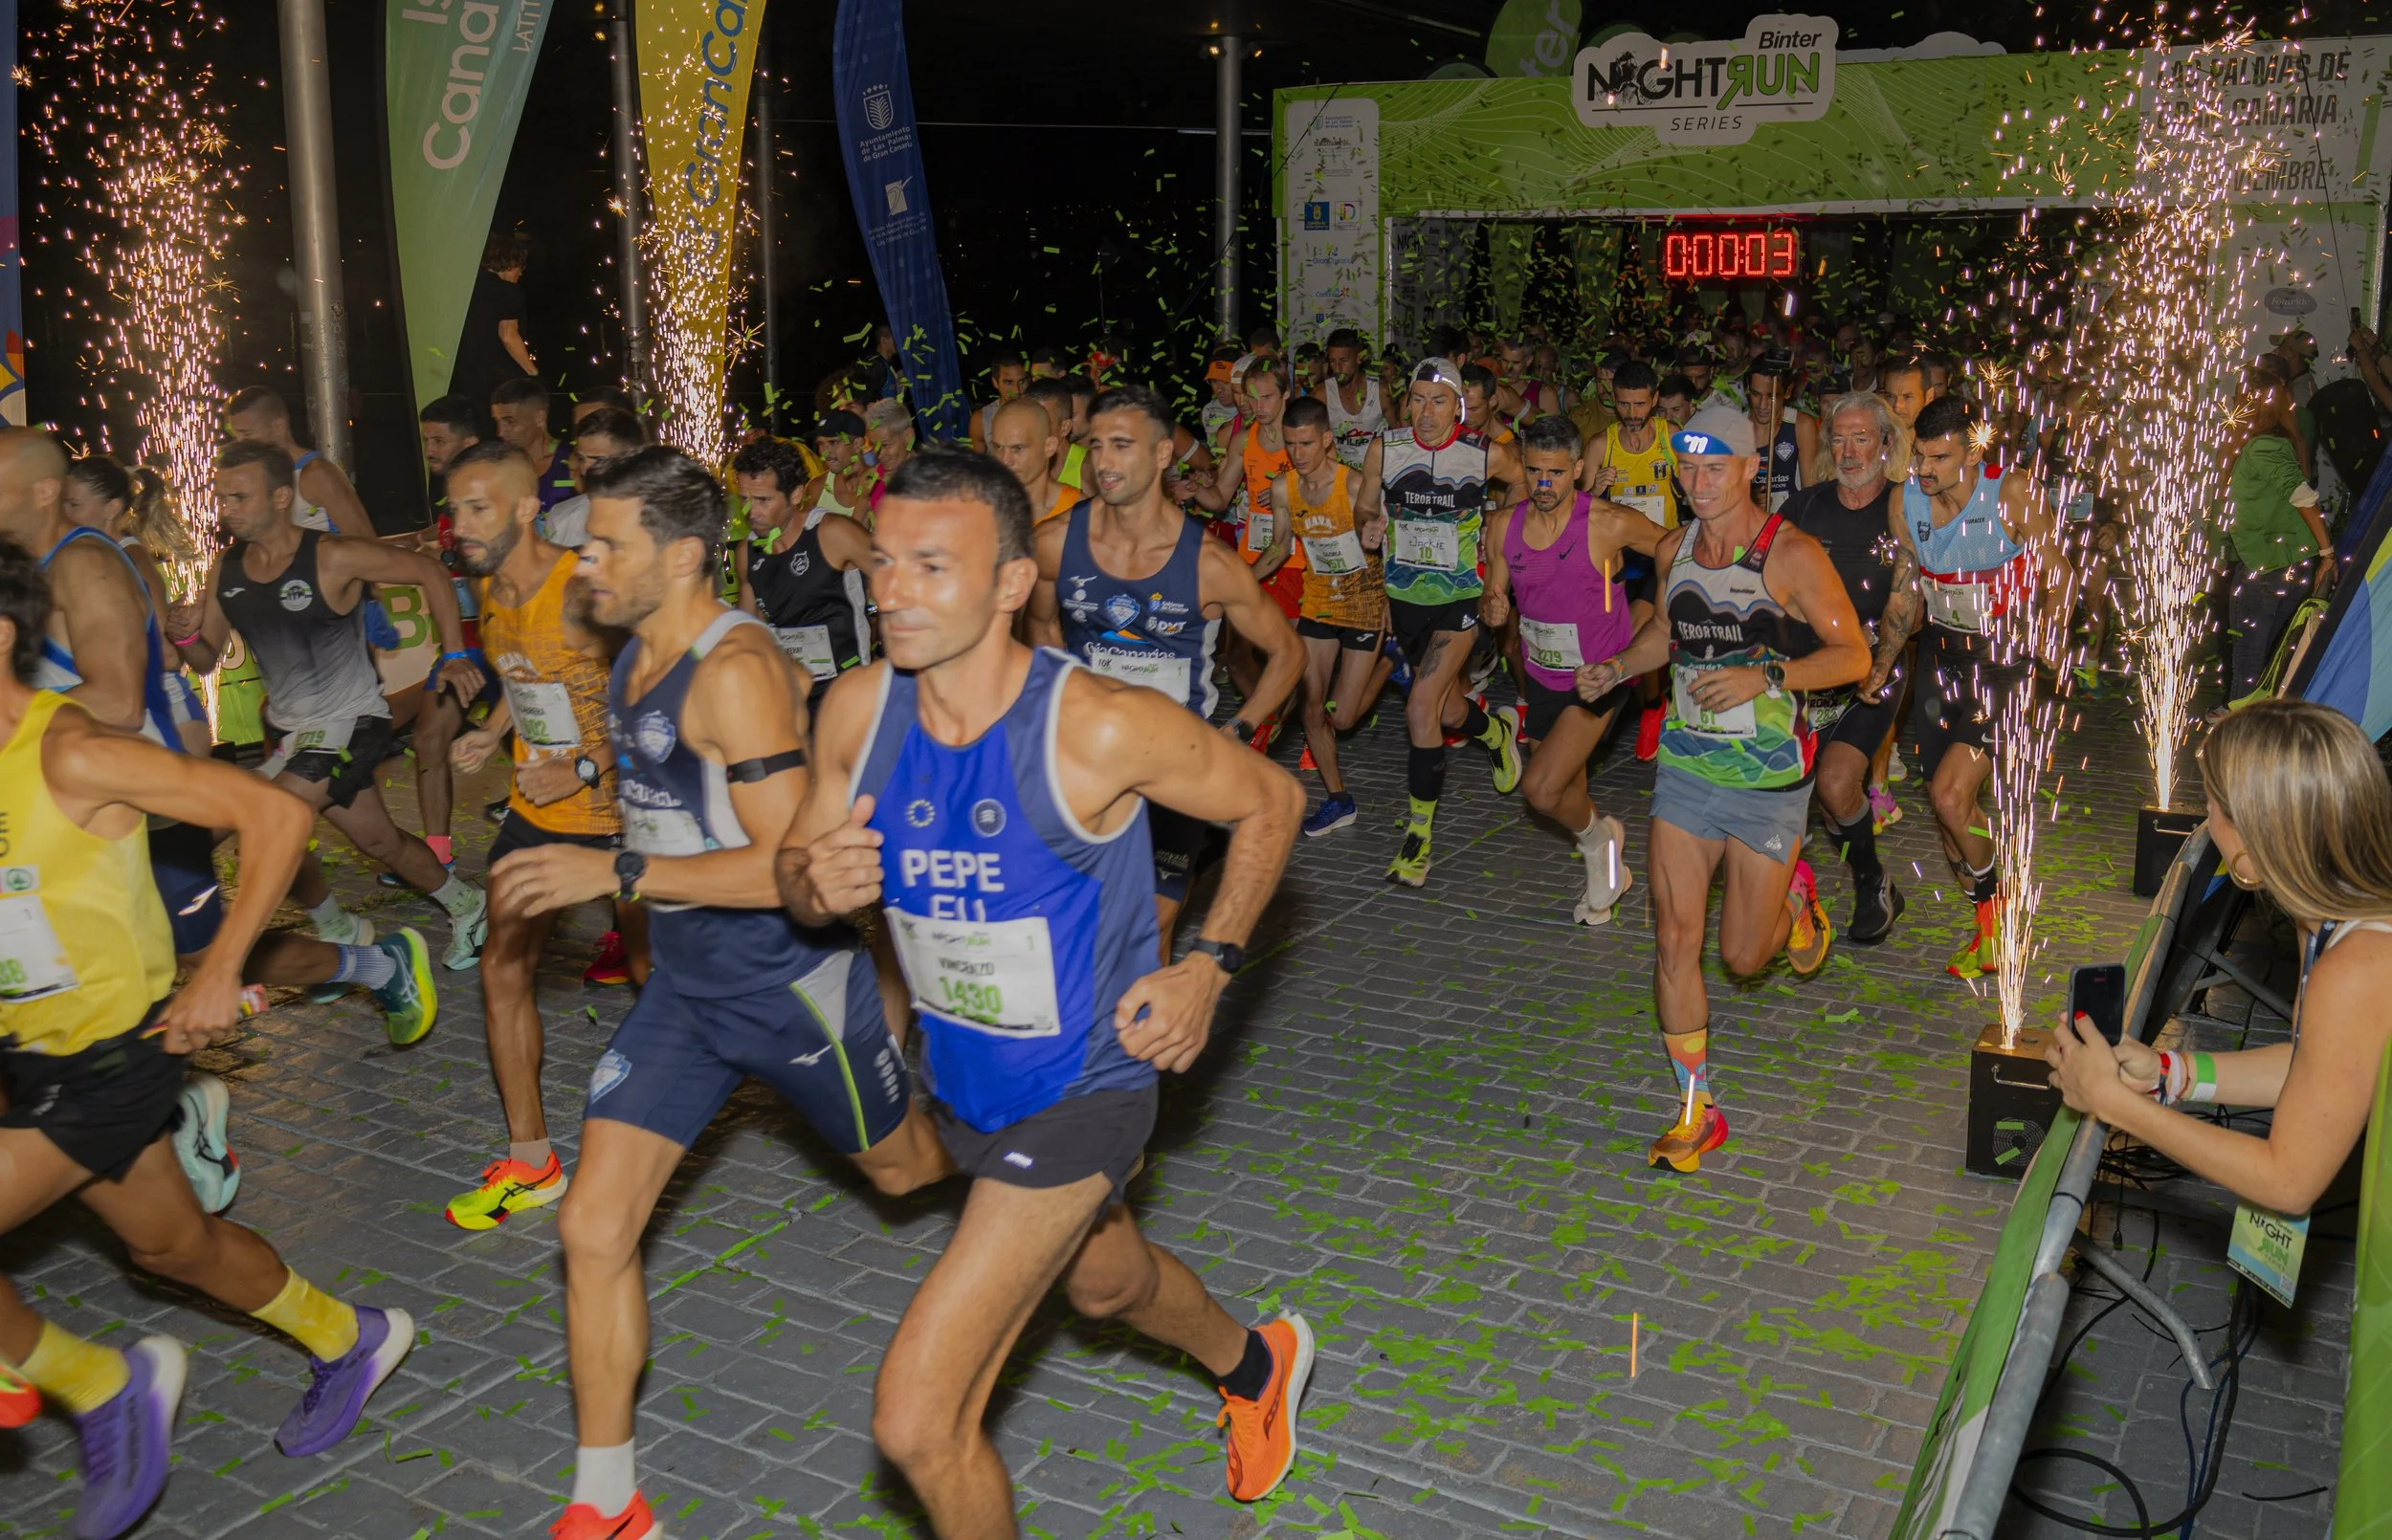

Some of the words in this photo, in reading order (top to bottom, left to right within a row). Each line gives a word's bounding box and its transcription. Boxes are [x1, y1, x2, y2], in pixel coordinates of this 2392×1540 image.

[1759, 31, 1823, 50] Binter
[2209, 53, 2312, 87] PALMAS
[2317, 51, 2352, 82] DE
[2231, 95, 2338, 127] CANARIA
[1671, 115, 1743, 132] SERIES
[860, 126, 911, 147] Ayuntamiento
[861, 147, 871, 156] de
[873, 143, 886, 151] Las
[888, 134, 912, 145] Palmas
[863, 154, 872, 163] de
[873, 148, 889, 160] Gran
[889, 141, 913, 153] Canaria
[1667, 233, 1793, 276] 0:00:03
[1405, 491, 1431, 505] TEROR
[1432, 494, 1455, 508] TRAIL
[1419, 546, 1433, 560] 10
[1712, 625, 1744, 644] TRAIL
[901, 848, 1005, 892] PEPE
[939, 976, 1002, 1015] 1430
